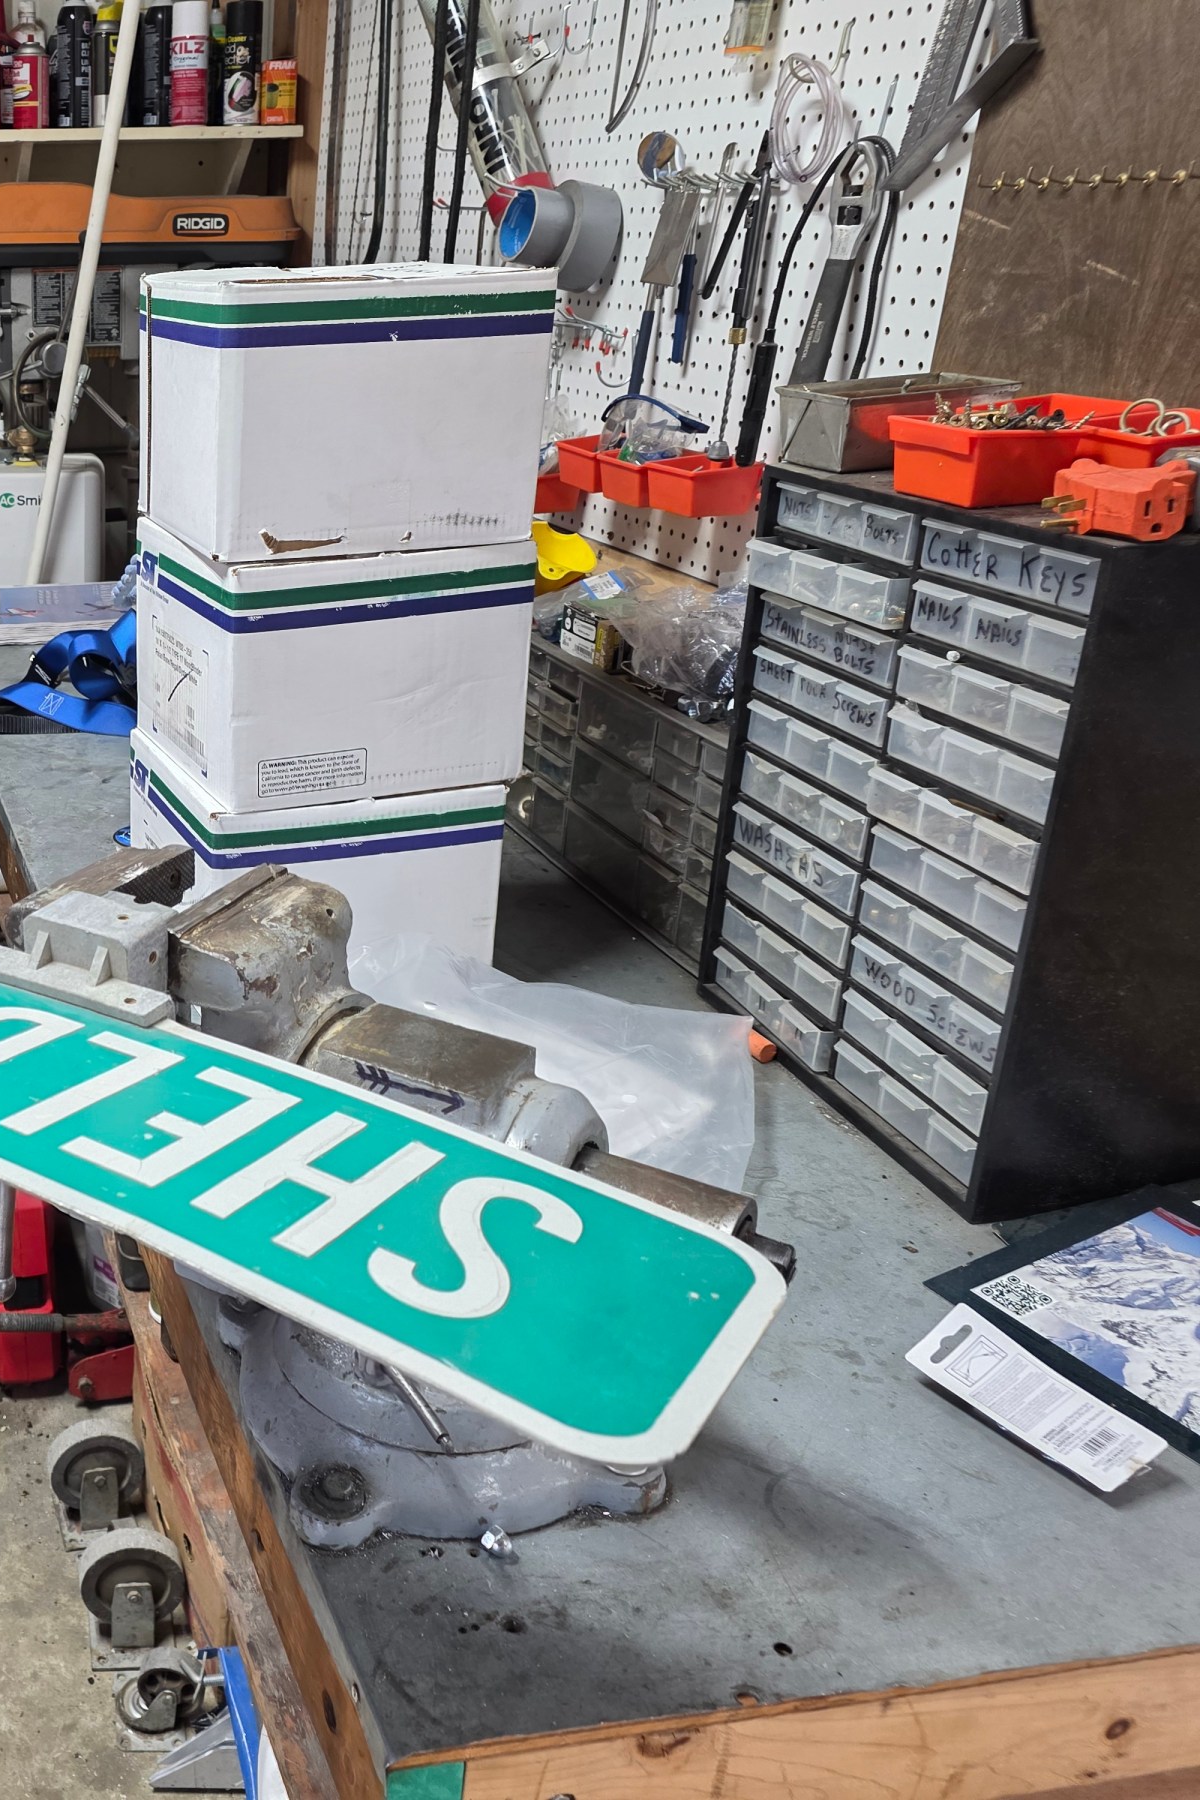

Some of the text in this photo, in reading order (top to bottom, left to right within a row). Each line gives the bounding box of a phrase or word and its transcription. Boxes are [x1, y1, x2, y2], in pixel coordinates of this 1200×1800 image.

[170, 41, 205, 55] KILZ
[269, 61, 296, 70] FRAM
[176, 217, 226, 230] RIDGID
[17, 494, 41, 506] Smi
[1018, 550, 1087, 604] KEYS
[917, 597, 1023, 647] NAILS NAILS
[834, 646, 875, 675] BOLTS
[760, 659, 794, 685] SHEET
[831, 693, 877, 727] SCREWS
[268, 760, 296, 768] WARNING:
[307, 756, 327, 764] product
[261, 773, 283, 782] California
[336, 770, 363, 778] information
[738, 815, 825, 886] WASHERS
[864, 956, 998, 1063] WOOD SCREWS
